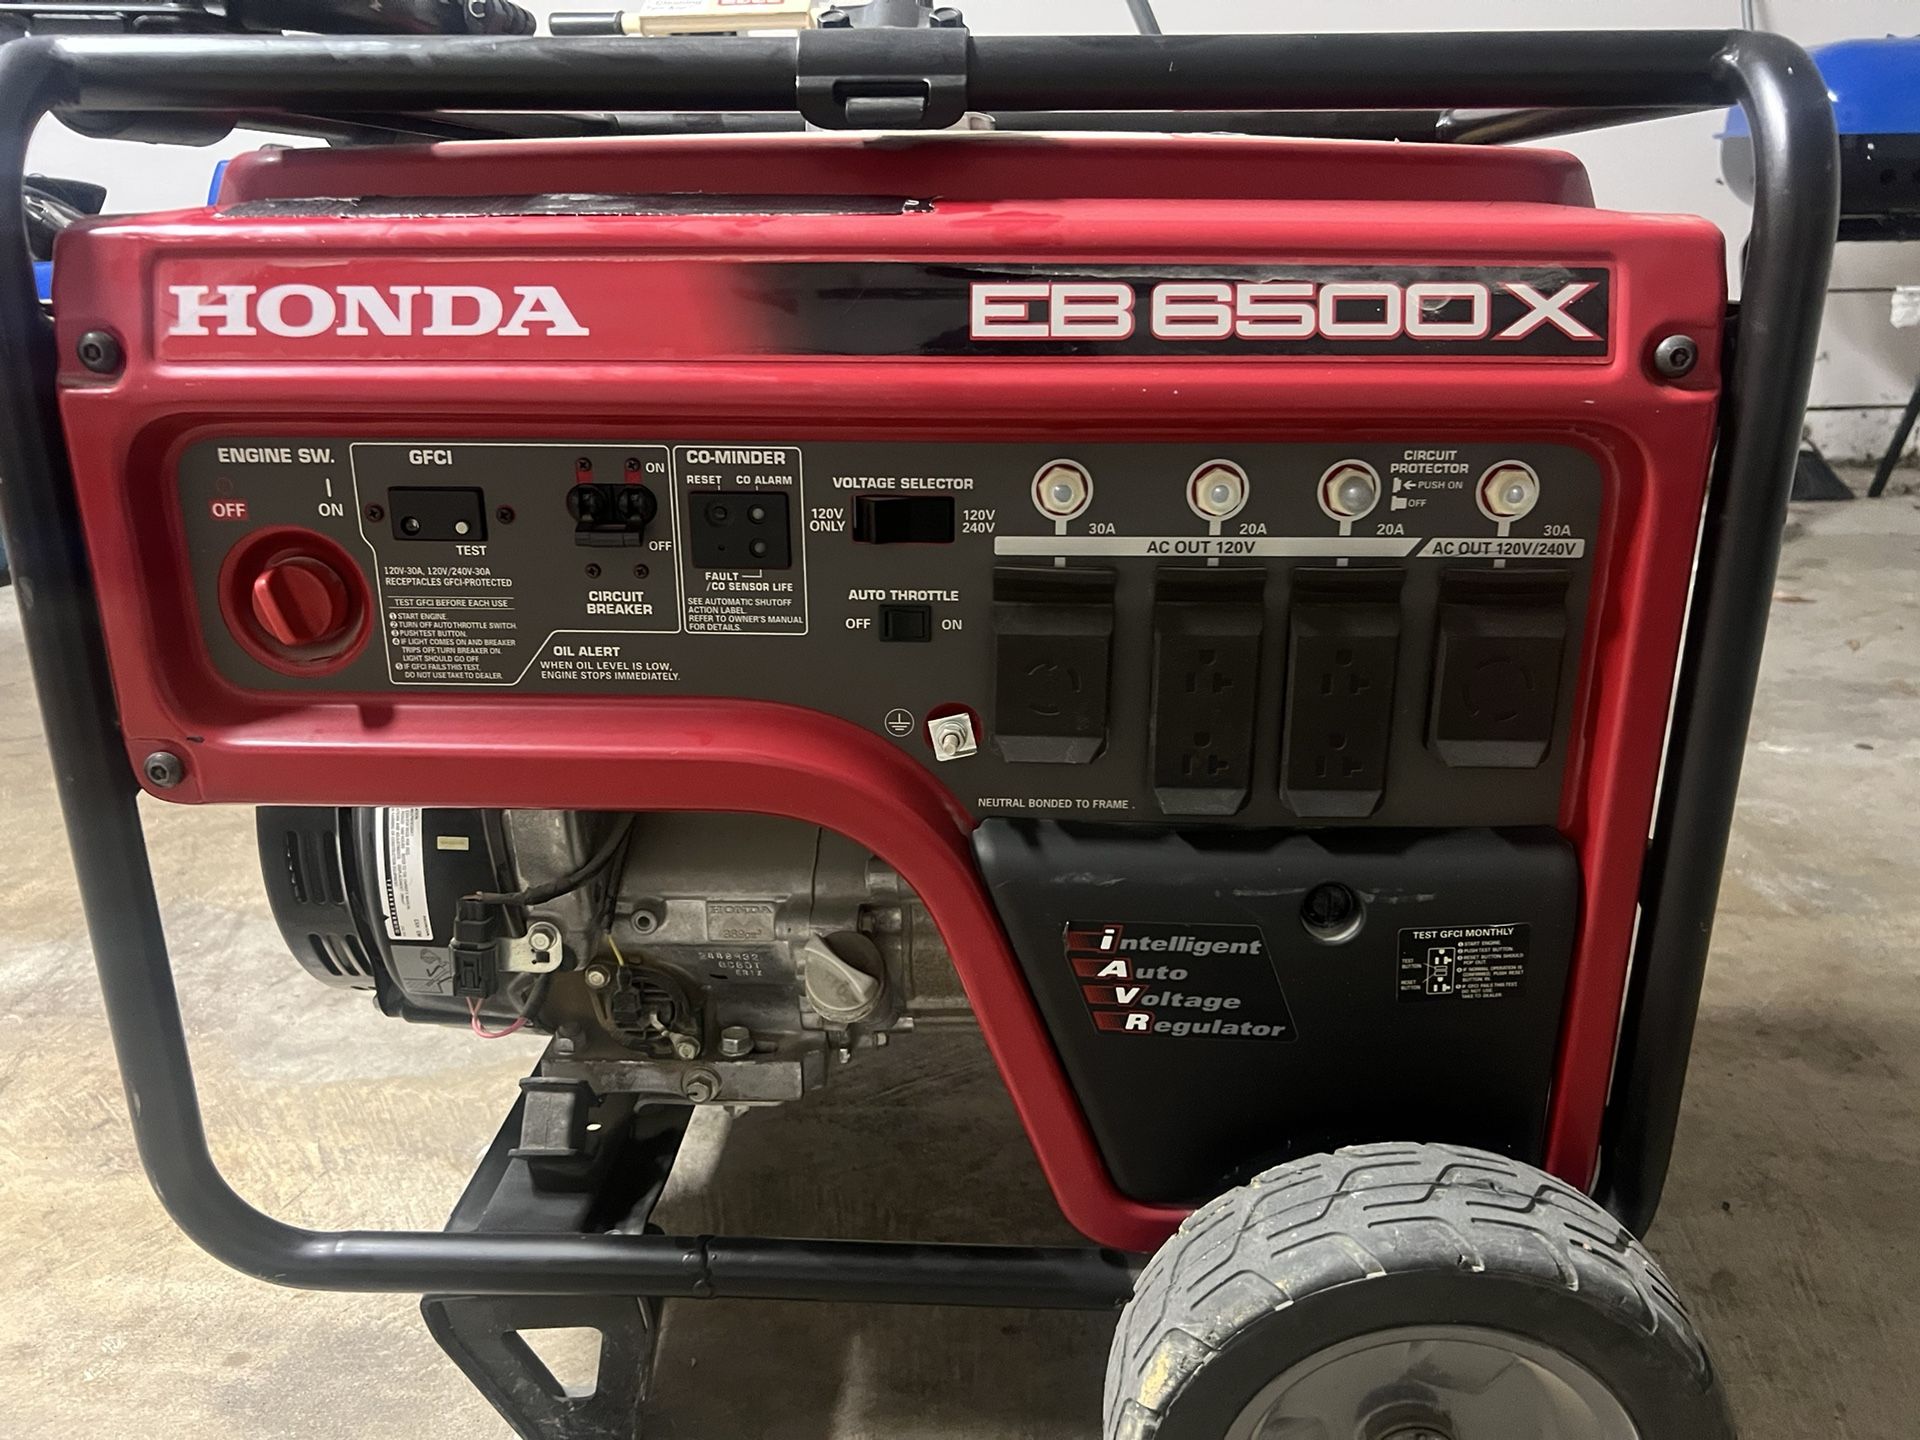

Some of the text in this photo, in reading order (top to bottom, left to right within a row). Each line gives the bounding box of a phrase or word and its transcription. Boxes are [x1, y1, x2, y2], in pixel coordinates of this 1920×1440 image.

[169, 283, 589, 337] HONDA
[217, 447, 335, 464] ENGINE SW.
[409, 450, 453, 465] GFCI
[686, 450, 786, 465] CO-MINDER
[1404, 450, 1457, 461] CIRCUIT
[645, 463, 665, 473] ON
[1390, 463, 1469, 474] PROTECTOR
[686, 475, 722, 484] RESET
[736, 476, 792, 485] CO ALARM
[832, 477, 974, 490] VOLTAGE SELECTOR
[1417, 481, 1463, 490] PUSH ON
[1408, 499, 1427, 508] OFF
[212, 503, 246, 517] OFF
[318, 503, 344, 517] ON
[811, 508, 844, 519] 120V
[963, 509, 996, 521] 120V
[809, 520, 846, 532] ONLY
[962, 522, 996, 534] 240V
[1088, 523, 1116, 535] 30A
[1239, 523, 1267, 535] 20A
[1376, 523, 1405, 536] 20A
[1543, 524, 1572, 537] 30A
[456, 545, 487, 556] TEST
[649, 541, 672, 551] OFF
[1146, 541, 1256, 554] AC OUT 120V
[1432, 542, 1576, 556] AC OUT 120V/240V
[427, 567, 491, 576] 120V/240V-30A
[705, 572, 739, 581] FAULT
[385, 578, 512, 588] RECEPTACLES GFCI-PROTECTED
[728, 583, 770, 592] SENSOR
[772, 583, 794, 592] LIFE
[588, 590, 644, 602] CIRCUIT
[848, 589, 959, 601] AUTO THROTTLE
[436, 599, 467, 607] BEFORE
[687, 597, 792, 606] SEE AUTOMATIC SHUTOFF
[587, 604, 653, 615] BREAKER
[688, 606, 719, 614] ACTION
[689, 615, 803, 624] REFER TO OWNER'S MANUAL
[845, 618, 871, 629] OFF
[941, 619, 962, 630] ON
[553, 646, 621, 657] OIL ALERT
[540, 661, 573, 669] WHEN
[576, 662, 594, 670] OIL
[596, 662, 629, 670] LEVEL
[632, 662, 643, 670] IS
[541, 671, 578, 680] ENGINE
[580, 672, 612, 680] STOPS
[978, 798, 1025, 808] NEUTRAL
[1028, 799, 1072, 809] BONDED
[1075, 800, 1090, 809] TO
[709, 905, 773, 914] HONDA
[1413, 927, 1514, 939] TEST GFCI MONTHLY
